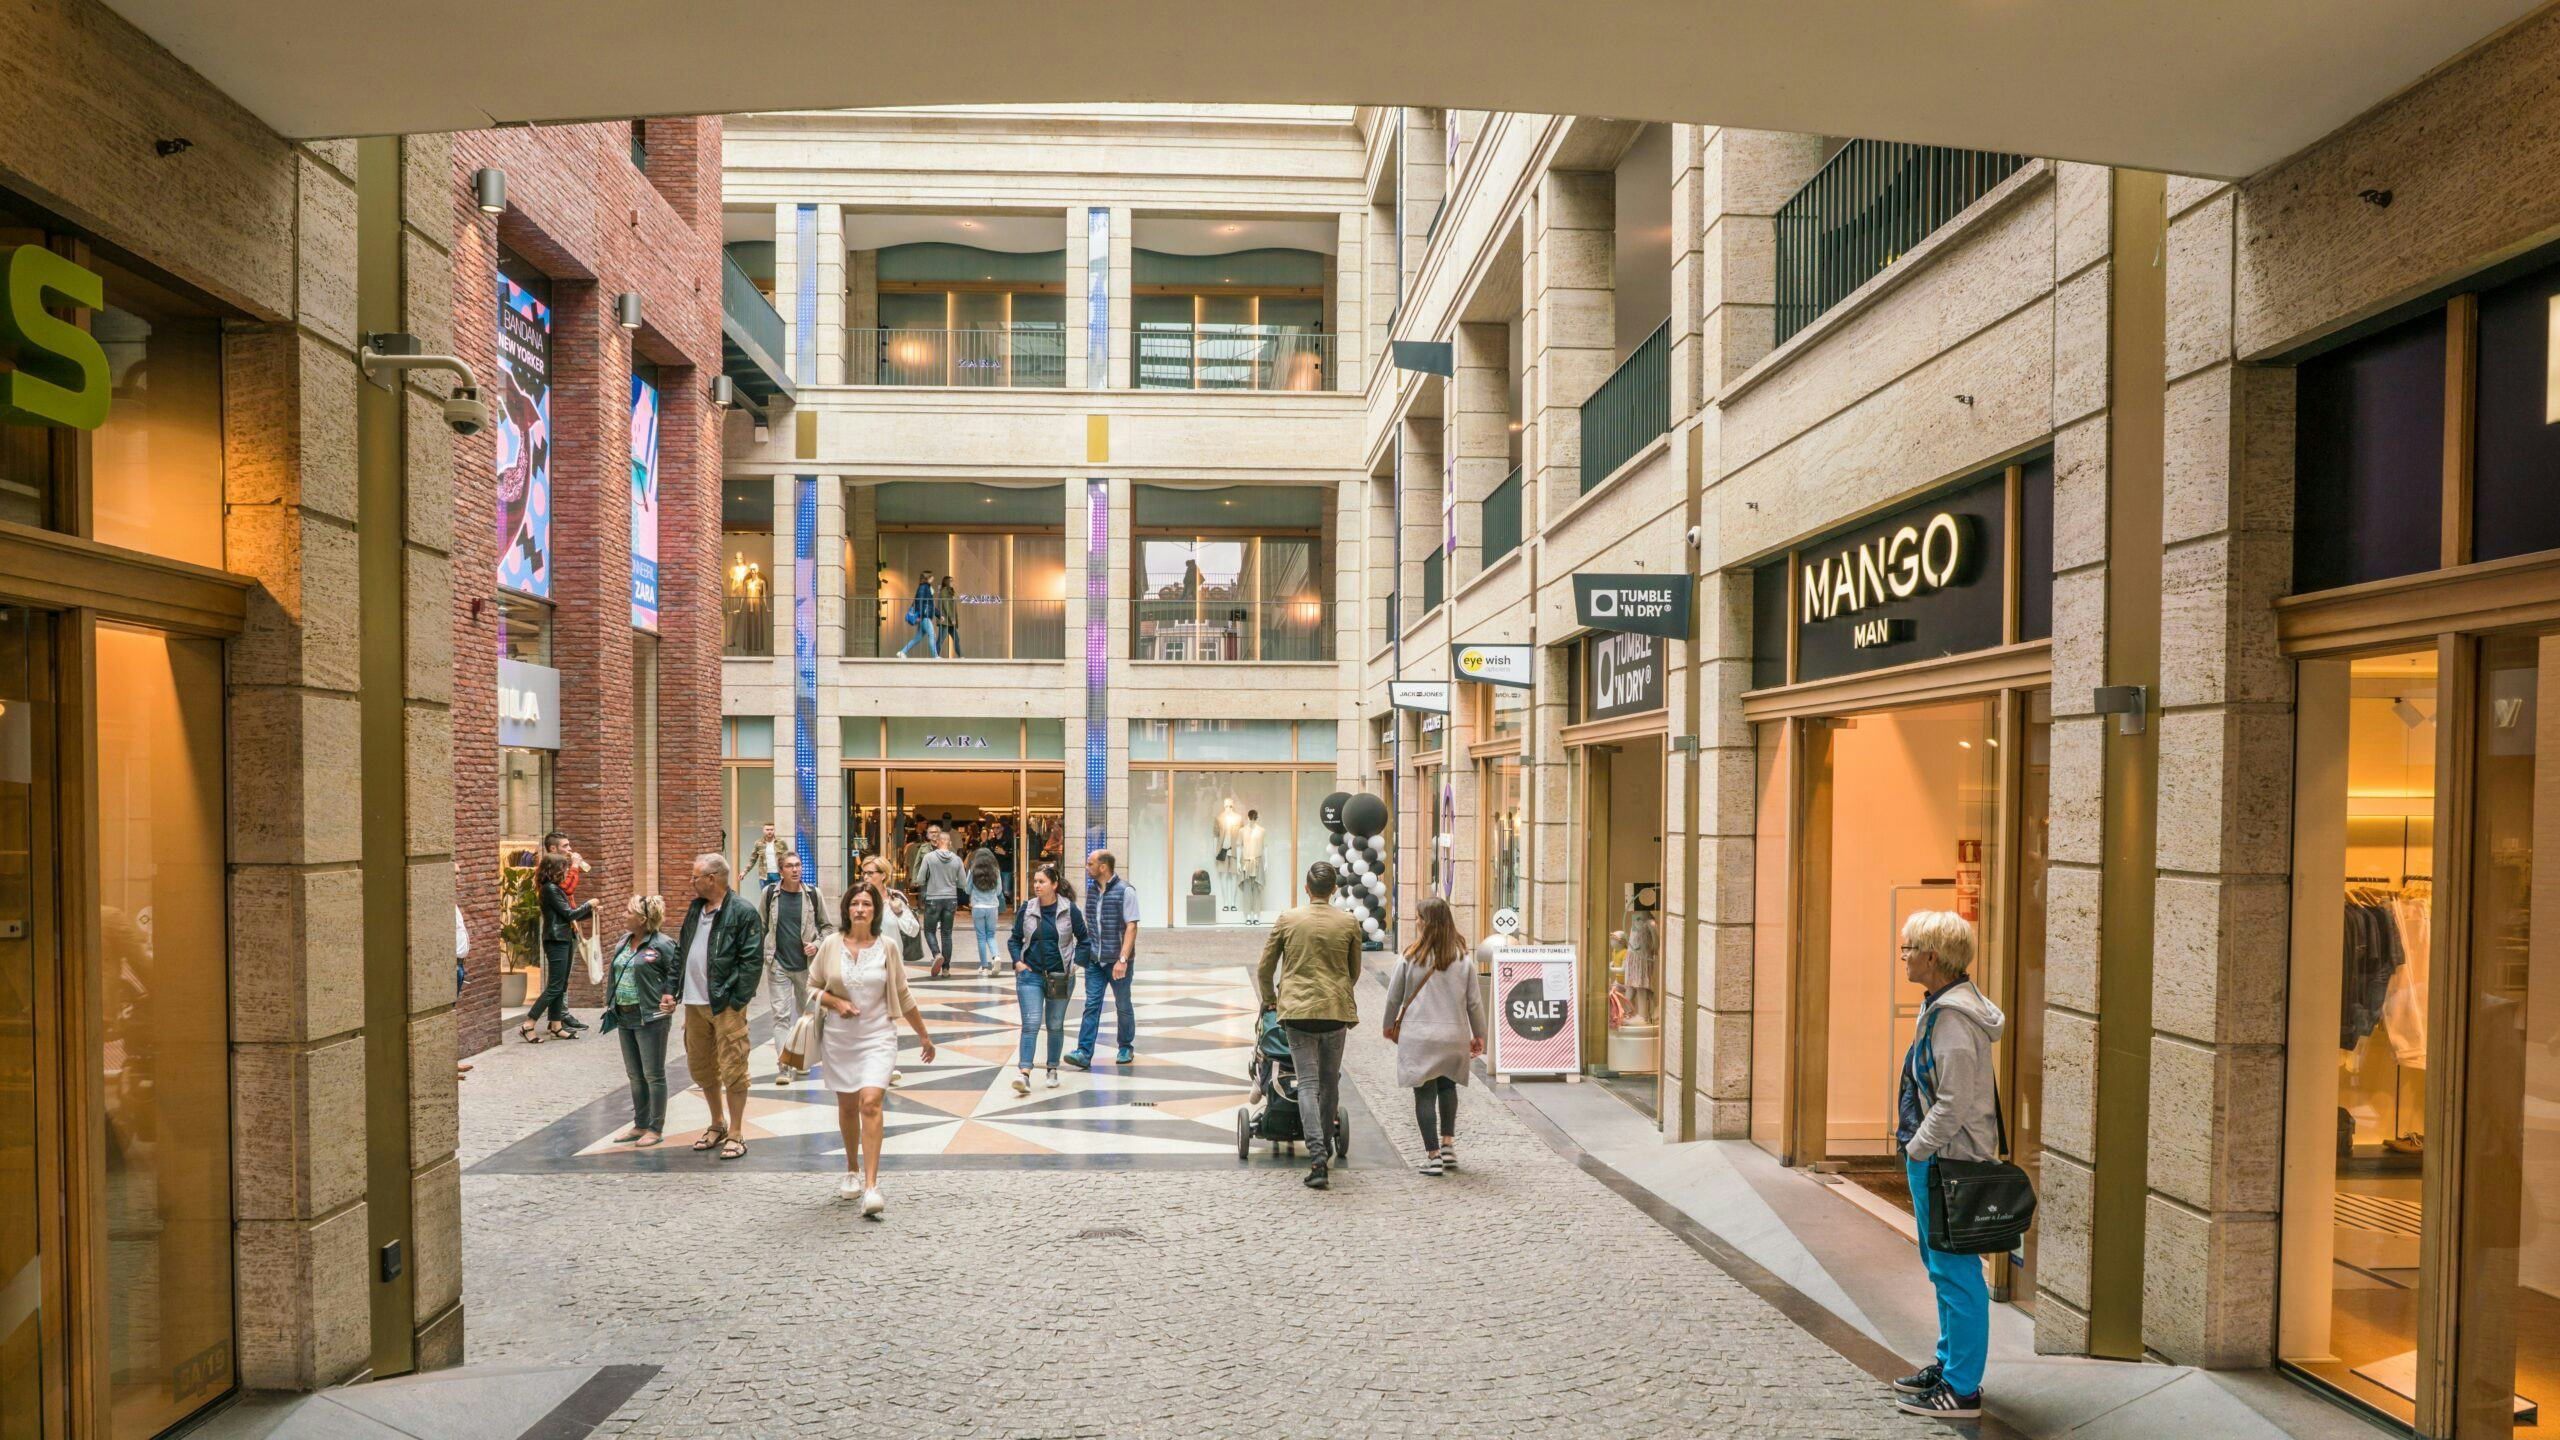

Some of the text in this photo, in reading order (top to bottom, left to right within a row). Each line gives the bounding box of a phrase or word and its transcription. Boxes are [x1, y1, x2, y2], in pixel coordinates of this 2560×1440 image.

[504, 309, 544, 353] BANDANA
[498, 331, 545, 375] NEW YORKER
[958, 359, 1001, 368] ZARA
[1804, 512, 1959, 625] MANGO
[635, 580, 655, 604] ZARA
[959, 594, 1002, 604] ZARA
[1619, 589, 1672, 602] TUMBLE
[1854, 617, 1888, 649] MAN
[1616, 631, 1652, 666] TUMBLE
[1463, 655, 1511, 668] eye wish
[925, 735, 989, 748] ZARA
[1512, 1000, 1561, 1019] SALE
